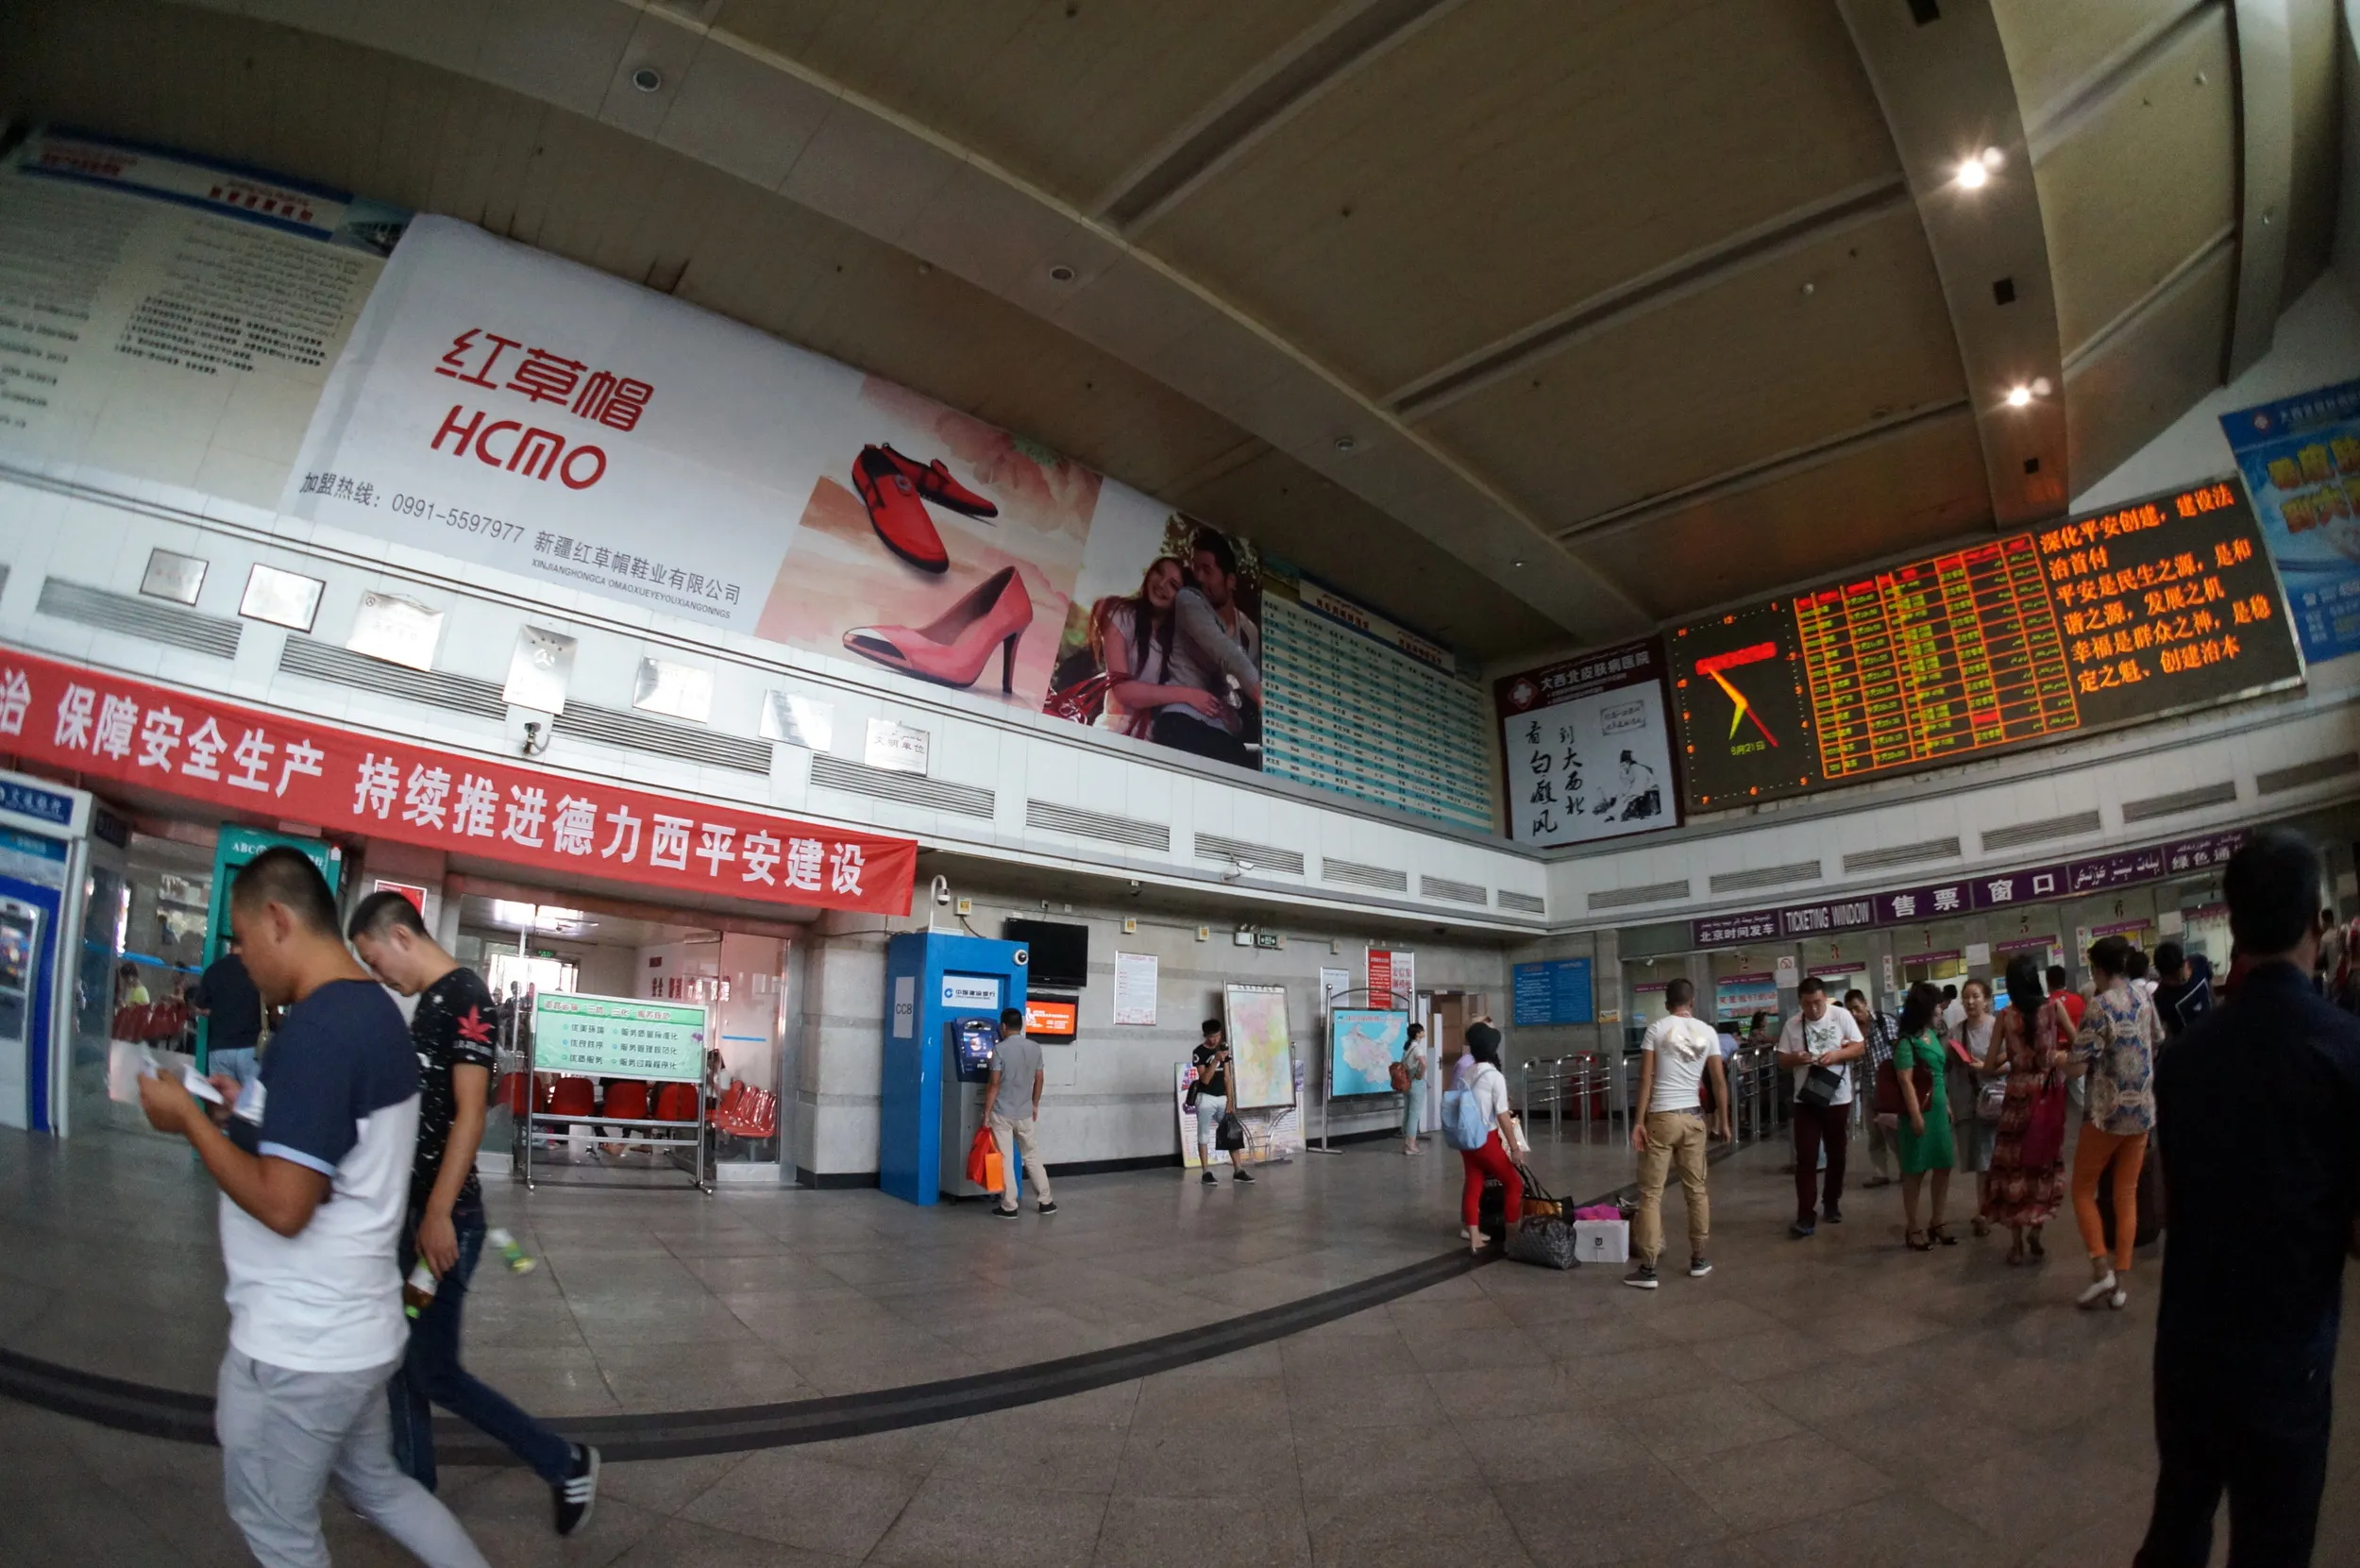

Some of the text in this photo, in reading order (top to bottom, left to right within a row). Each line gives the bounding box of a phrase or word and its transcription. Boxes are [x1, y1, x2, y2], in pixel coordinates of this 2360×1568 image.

[434, 328, 654, 433] 红草帽
[430, 404, 606, 491] HCMO
[391, 493, 526, 545] 0991-5597977
[533, 530, 741, 605] 新疆红草帽鞋业有限公司
[1540, 652, 1650, 692] 大西北皮肤病医院
[54, 682, 325, 797] 保障安全生产
[353, 752, 866, 896] 持续推进德力西平安建设
[232, 840, 257, 857] ABC
[1785, 906, 1829, 932] TICKETING
[1831, 902, 1870, 926] WINDOW
[1891, 872, 2055, 918] 售票 窗口
[1699, 923, 1776, 942] 北京时间发车
[896, 1003, 913, 1016] CCB
